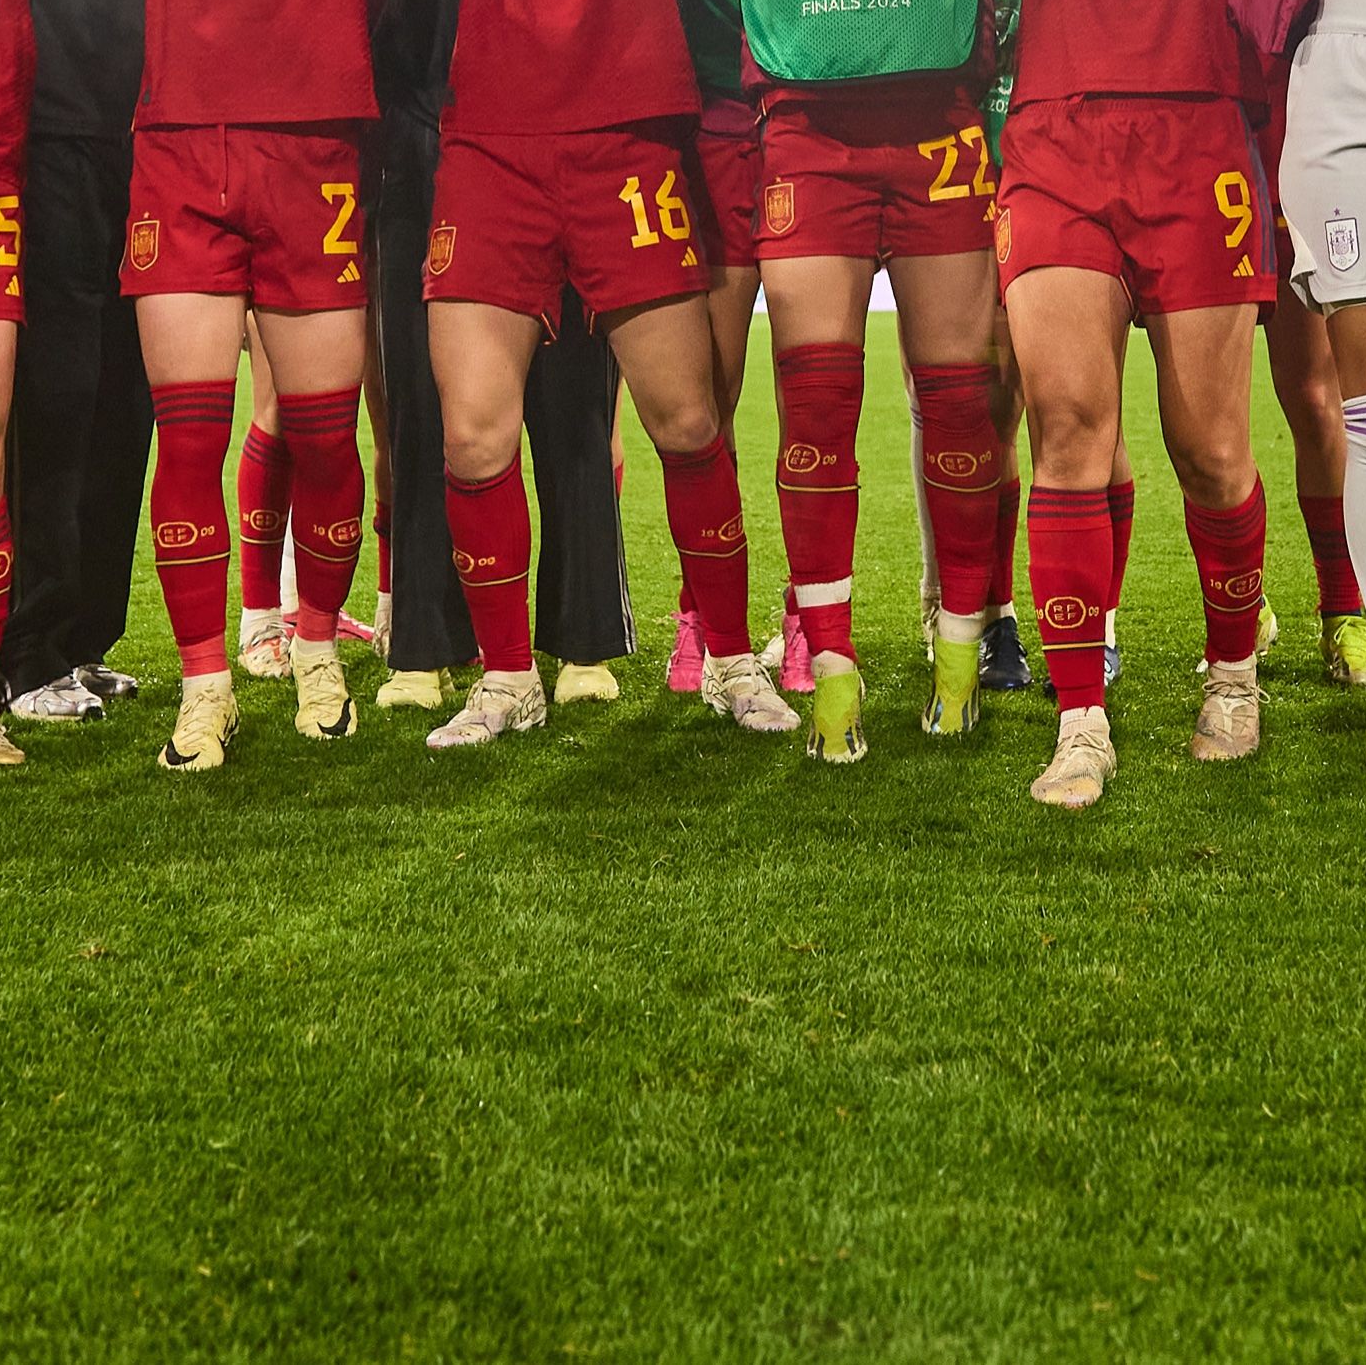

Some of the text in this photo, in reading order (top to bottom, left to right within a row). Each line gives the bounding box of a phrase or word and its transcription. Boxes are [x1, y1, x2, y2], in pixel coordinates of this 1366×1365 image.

[919, 125, 996, 201] 22
[321, 183, 358, 254] 2
[619, 170, 691, 248] 16
[1214, 171, 1253, 248] 9
[1053, 604, 1076, 613] RF
[1054, 613, 1077, 621] EF
